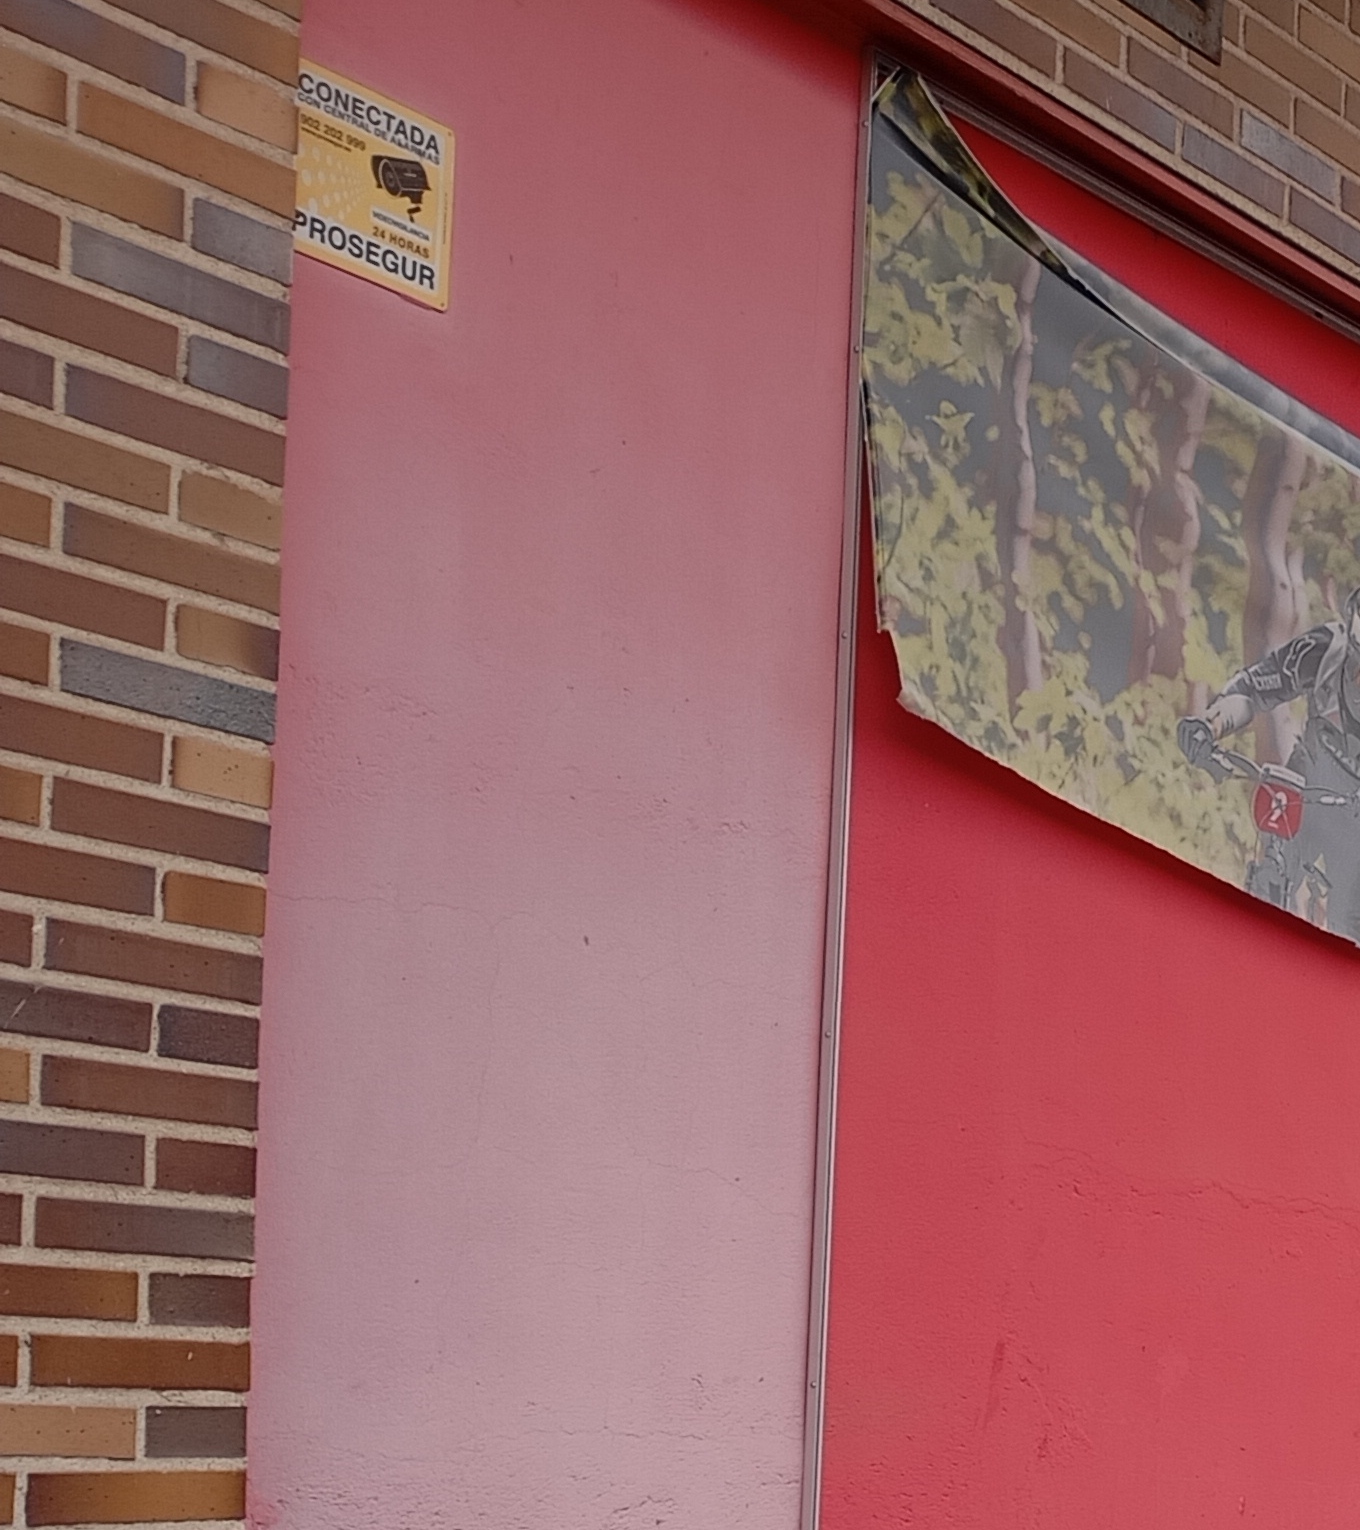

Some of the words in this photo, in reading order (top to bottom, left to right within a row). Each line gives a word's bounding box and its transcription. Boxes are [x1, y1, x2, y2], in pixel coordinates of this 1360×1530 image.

[298, 73, 439, 155] CONECTADA
[291, 208, 435, 290] PROSEGUR
[389, 233, 430, 259] HORAS
